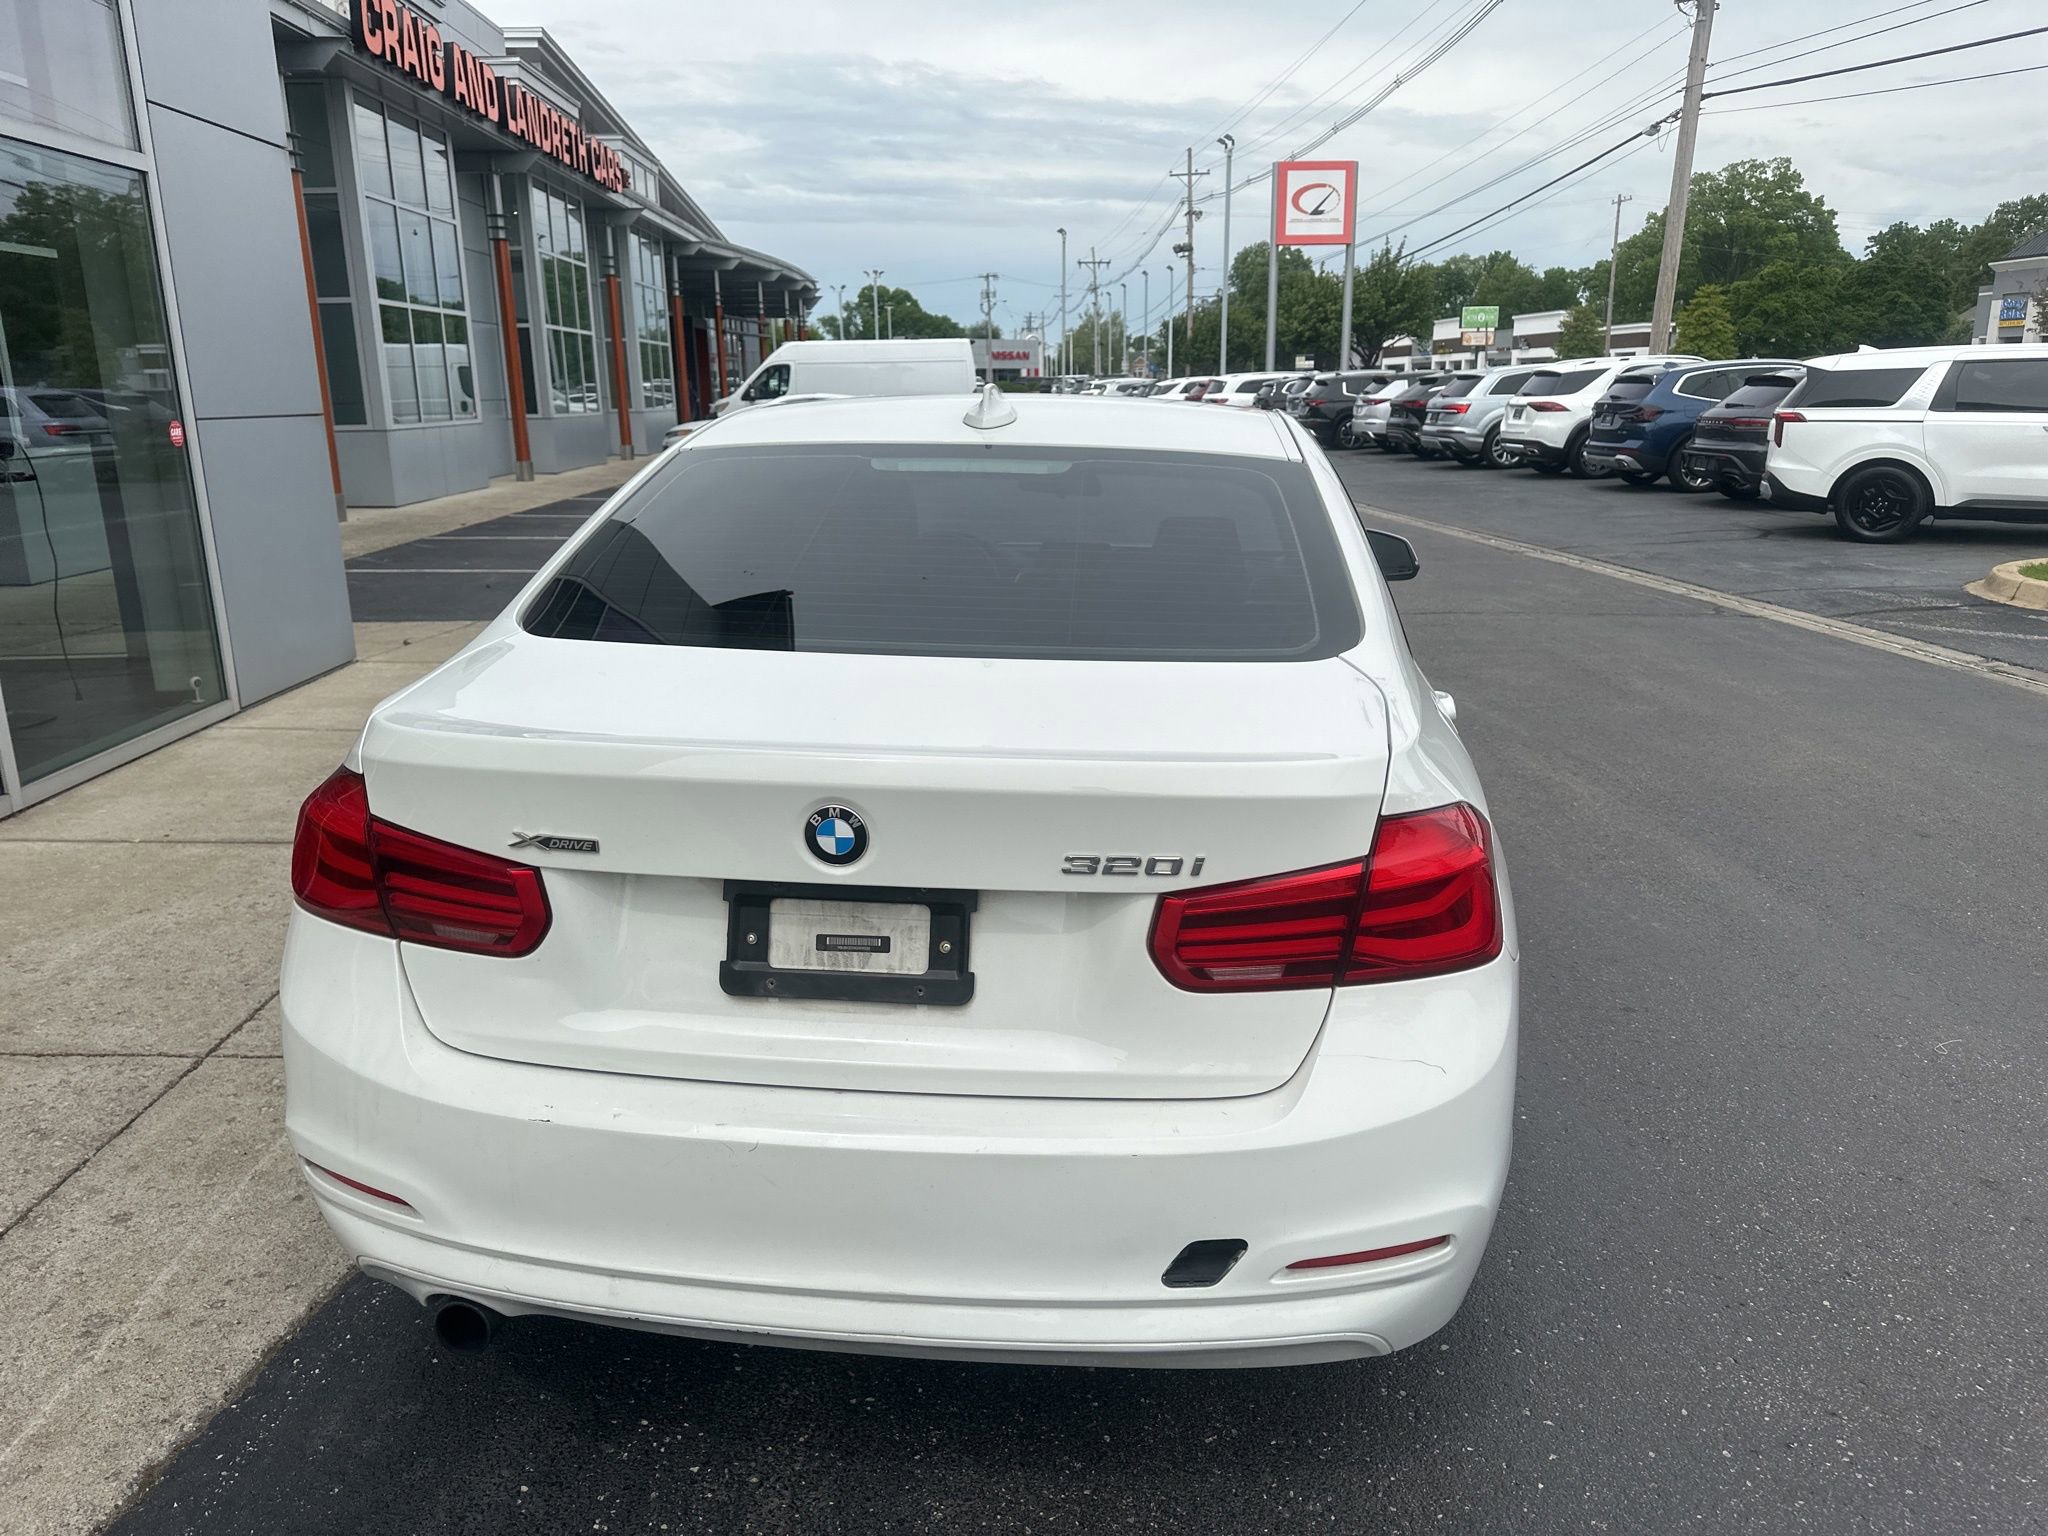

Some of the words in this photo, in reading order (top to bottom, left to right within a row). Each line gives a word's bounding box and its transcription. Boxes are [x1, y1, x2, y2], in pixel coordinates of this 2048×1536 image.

[361, 0, 445, 92] CRAIG
[453, 42, 499, 123] AND
[504, 79, 588, 175] LANDRETH
[591, 135, 623, 194] CARS
[809, 807, 862, 829] BMW
[1061, 855, 1206, 876] 320i
